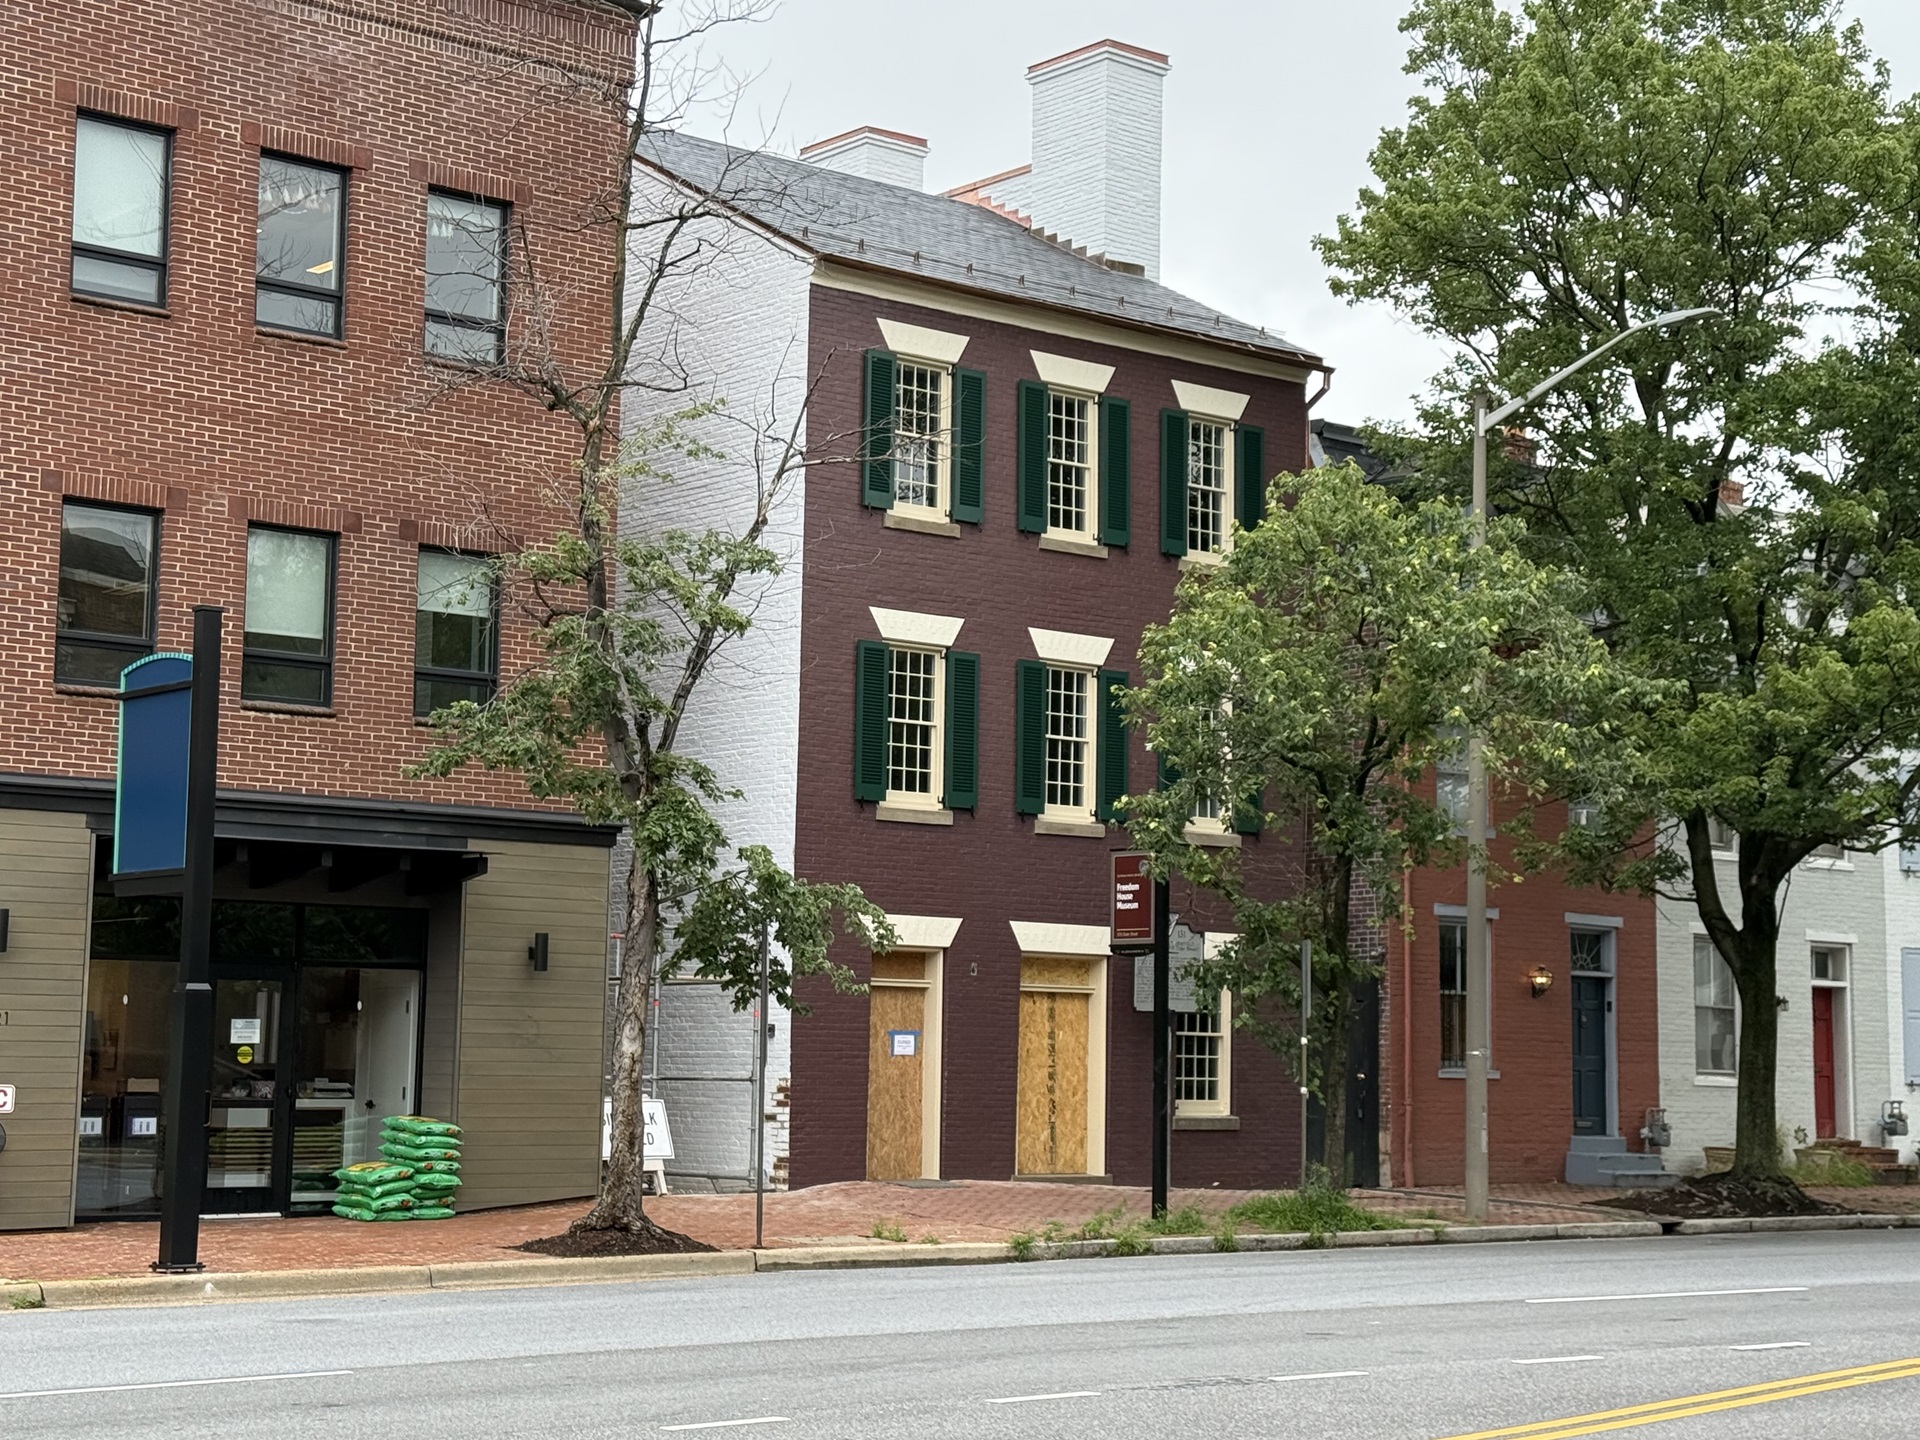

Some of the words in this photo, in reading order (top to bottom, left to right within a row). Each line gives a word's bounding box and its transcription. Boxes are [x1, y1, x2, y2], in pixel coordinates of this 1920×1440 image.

[1116, 882, 1140, 891] Freedom
[1116, 892, 1134, 900] House
[1116, 901, 1139, 910] Museum
